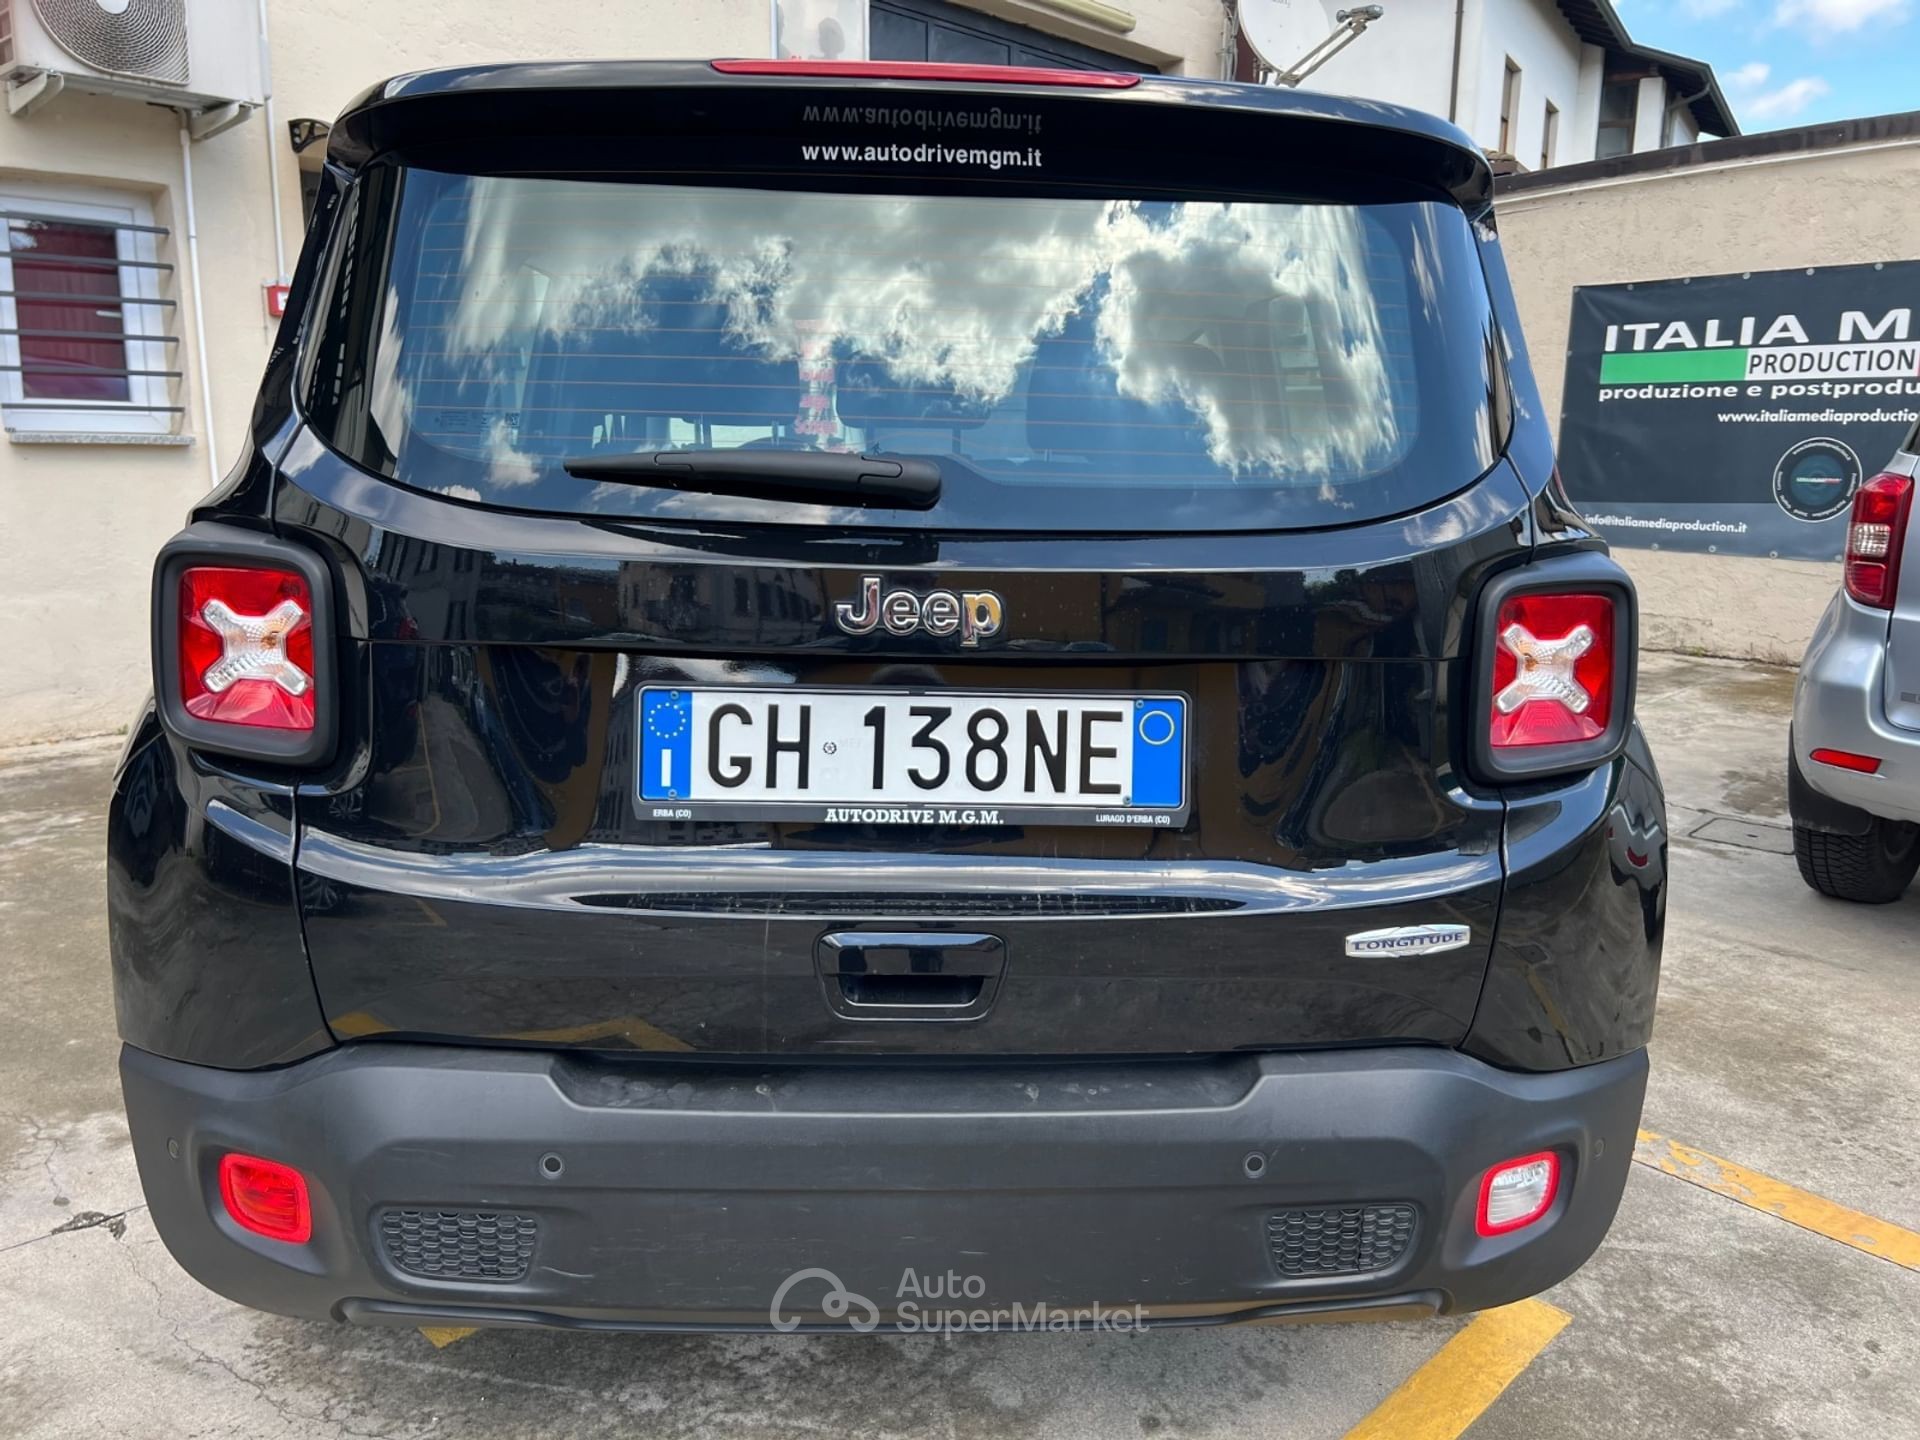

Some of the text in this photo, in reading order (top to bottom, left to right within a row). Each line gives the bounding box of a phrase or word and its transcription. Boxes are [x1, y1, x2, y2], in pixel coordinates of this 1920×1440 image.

[802, 144, 1042, 170] www.autodrivemgm.it
[1604, 314, 1810, 352] ITALIA
[1748, 348, 1916, 376] PRODUCTION
[1599, 384, 1738, 402] produzione
[1746, 385, 1762, 397] e
[1584, 514, 1747, 534] info@italiamediaproduction.it
[835, 576, 1003, 646] Jeep
[708, 703, 812, 790] GH
[864, 705, 1123, 795] 138NE
[652, 809, 692, 819] ERBA (CO)
[825, 808, 1004, 824] AUTODRIVE M.G.M.
[1155, 815, 1171, 825] (CO)
[1352, 932, 1464, 951] LONGITUDE
